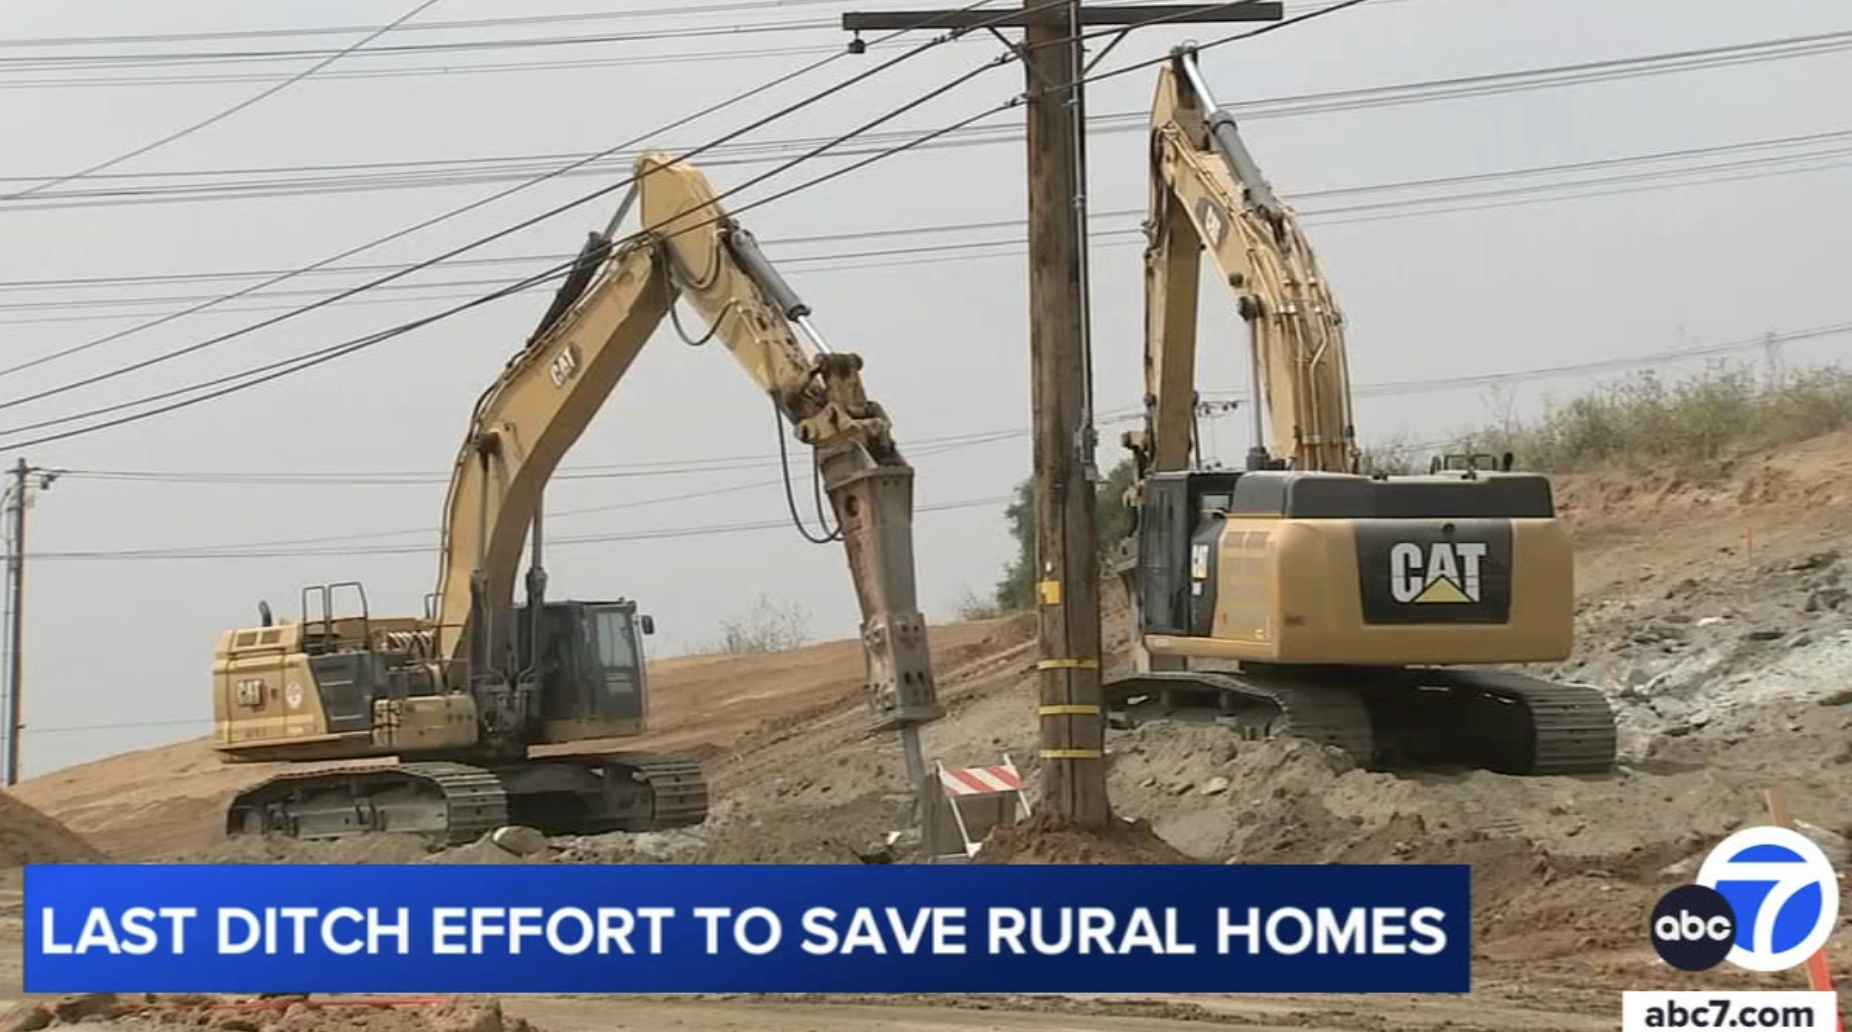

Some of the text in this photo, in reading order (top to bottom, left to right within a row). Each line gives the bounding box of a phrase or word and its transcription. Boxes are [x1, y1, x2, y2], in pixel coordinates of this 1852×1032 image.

[550, 345, 577, 388] CAT
[1390, 542, 1487, 603] CAT
[237, 680, 262, 706] CAT
